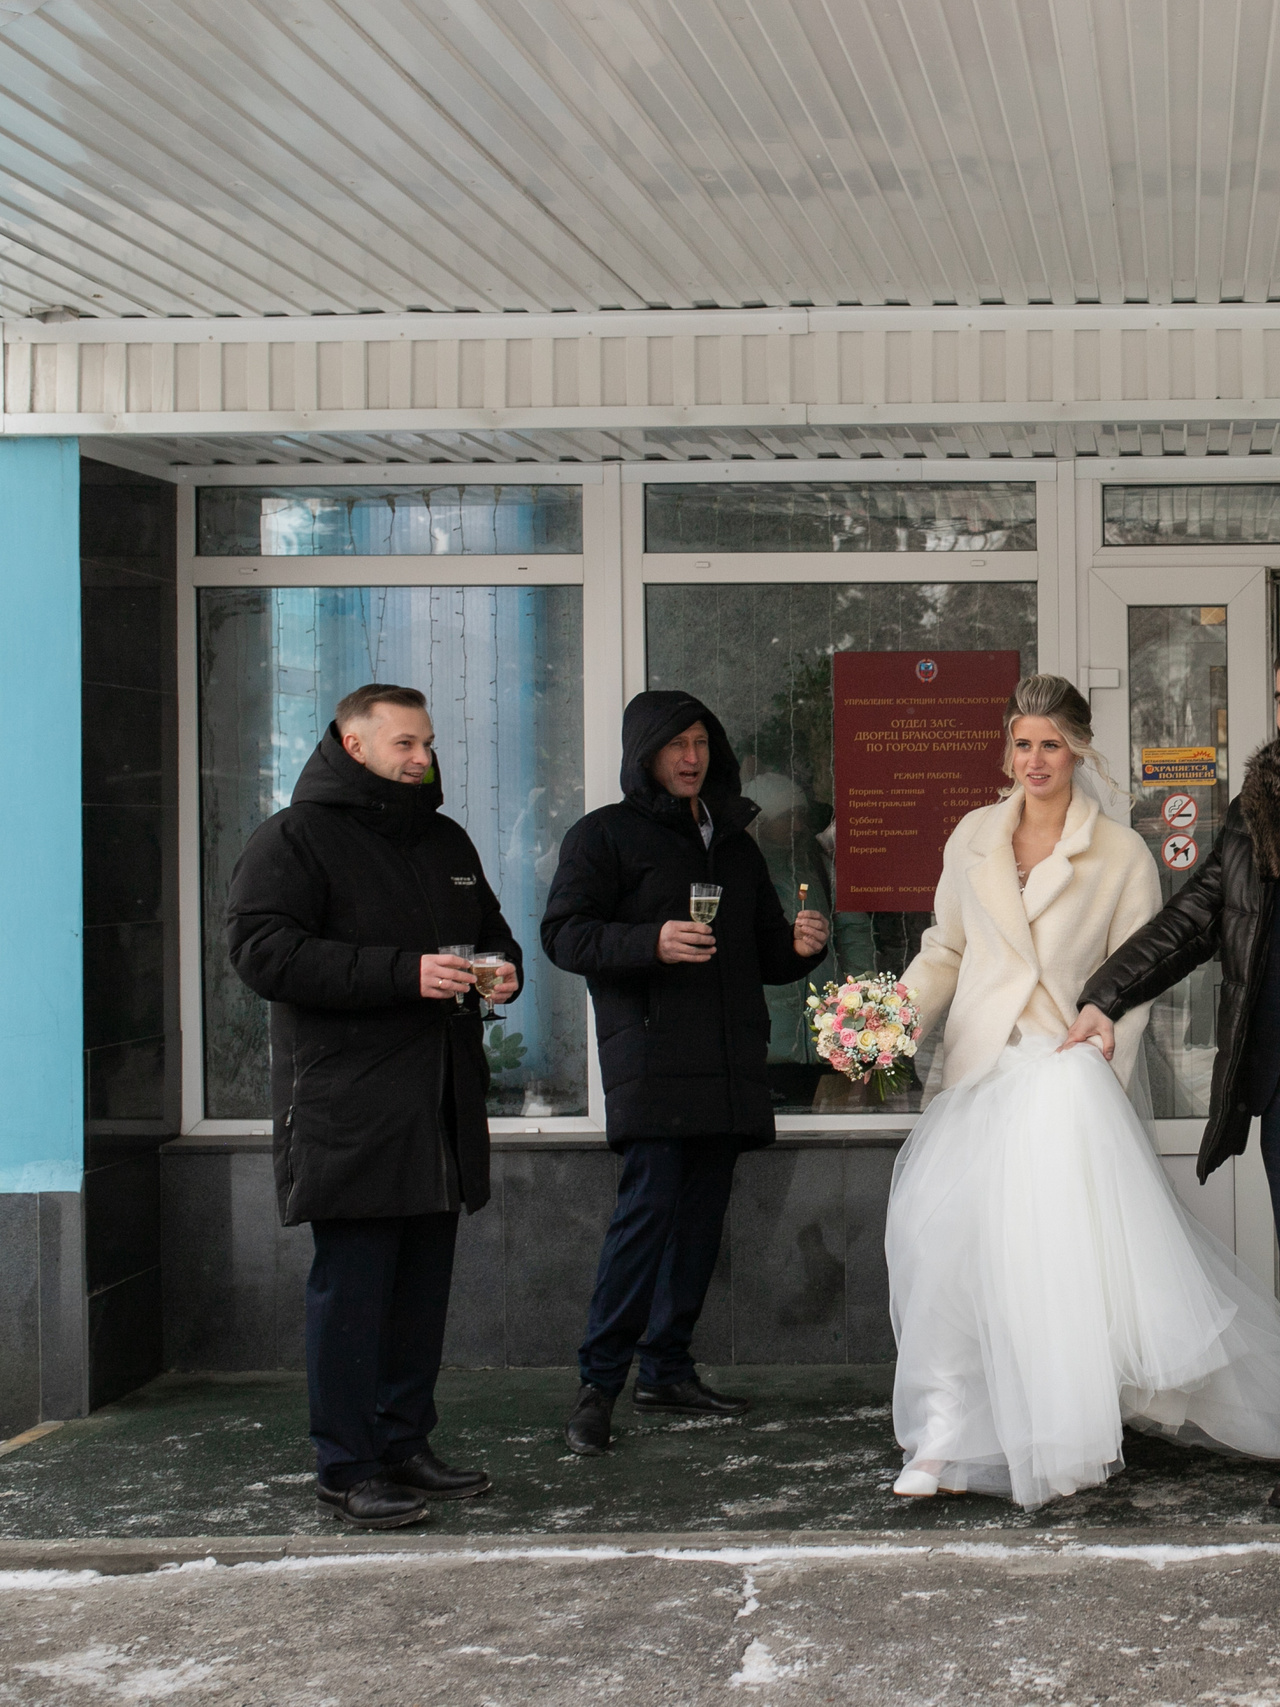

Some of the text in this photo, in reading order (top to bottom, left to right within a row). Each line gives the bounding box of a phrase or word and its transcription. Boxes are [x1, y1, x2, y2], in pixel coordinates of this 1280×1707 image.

[891, 719, 927, 728] ОТДЕЛ
[930, 719, 957, 728] ЗАГС
[854, 730, 1001, 742] ДВОРЕЦ БРАКОСОЧЕТАНИЯ
[866, 742, 989, 753] ПО ГОРОДУ БАРНАУЛУ
[894, 772, 962, 780] РЕЖИМ РАБОТЫ:
[849, 816, 883, 826] Суббота
